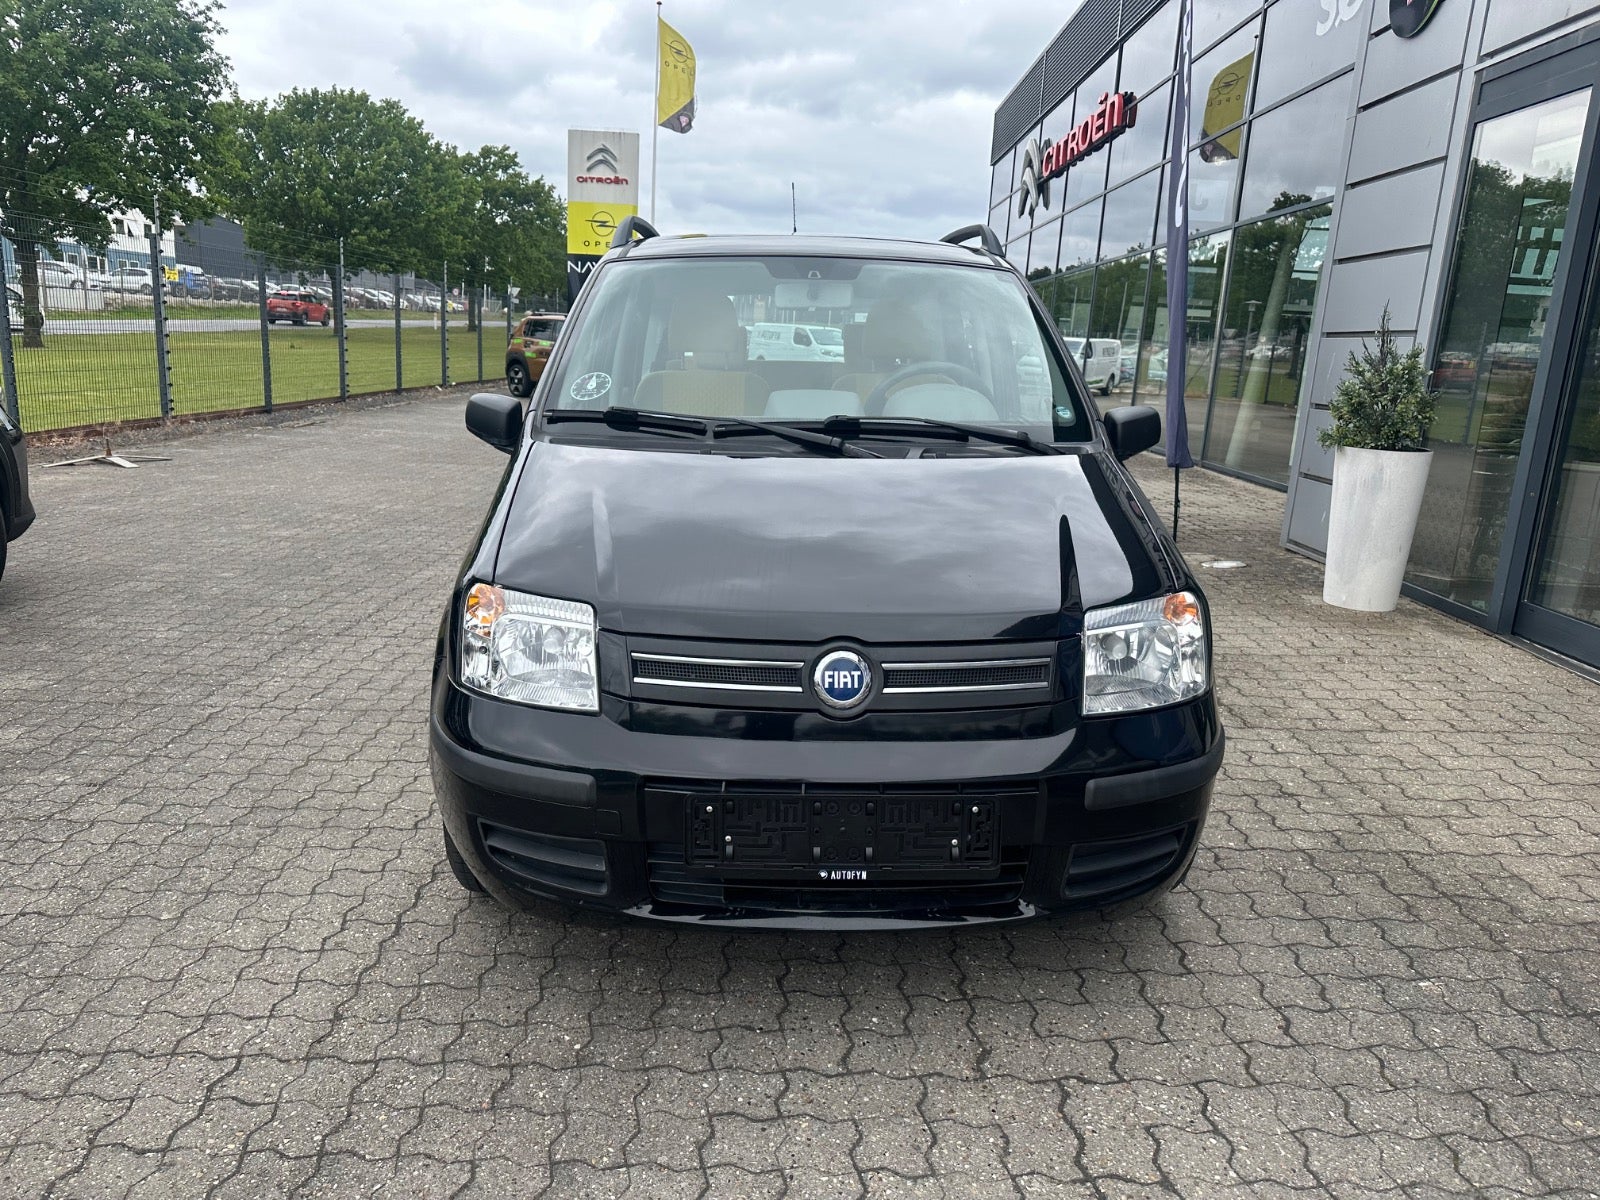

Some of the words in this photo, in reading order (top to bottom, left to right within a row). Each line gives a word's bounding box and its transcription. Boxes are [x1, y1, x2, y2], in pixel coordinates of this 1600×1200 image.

[664, 60, 694, 77] OPEL
[583, 240, 612, 248] OPE
[824, 670, 862, 689] FIAT
[830, 870, 867, 880] AUTOFYN
